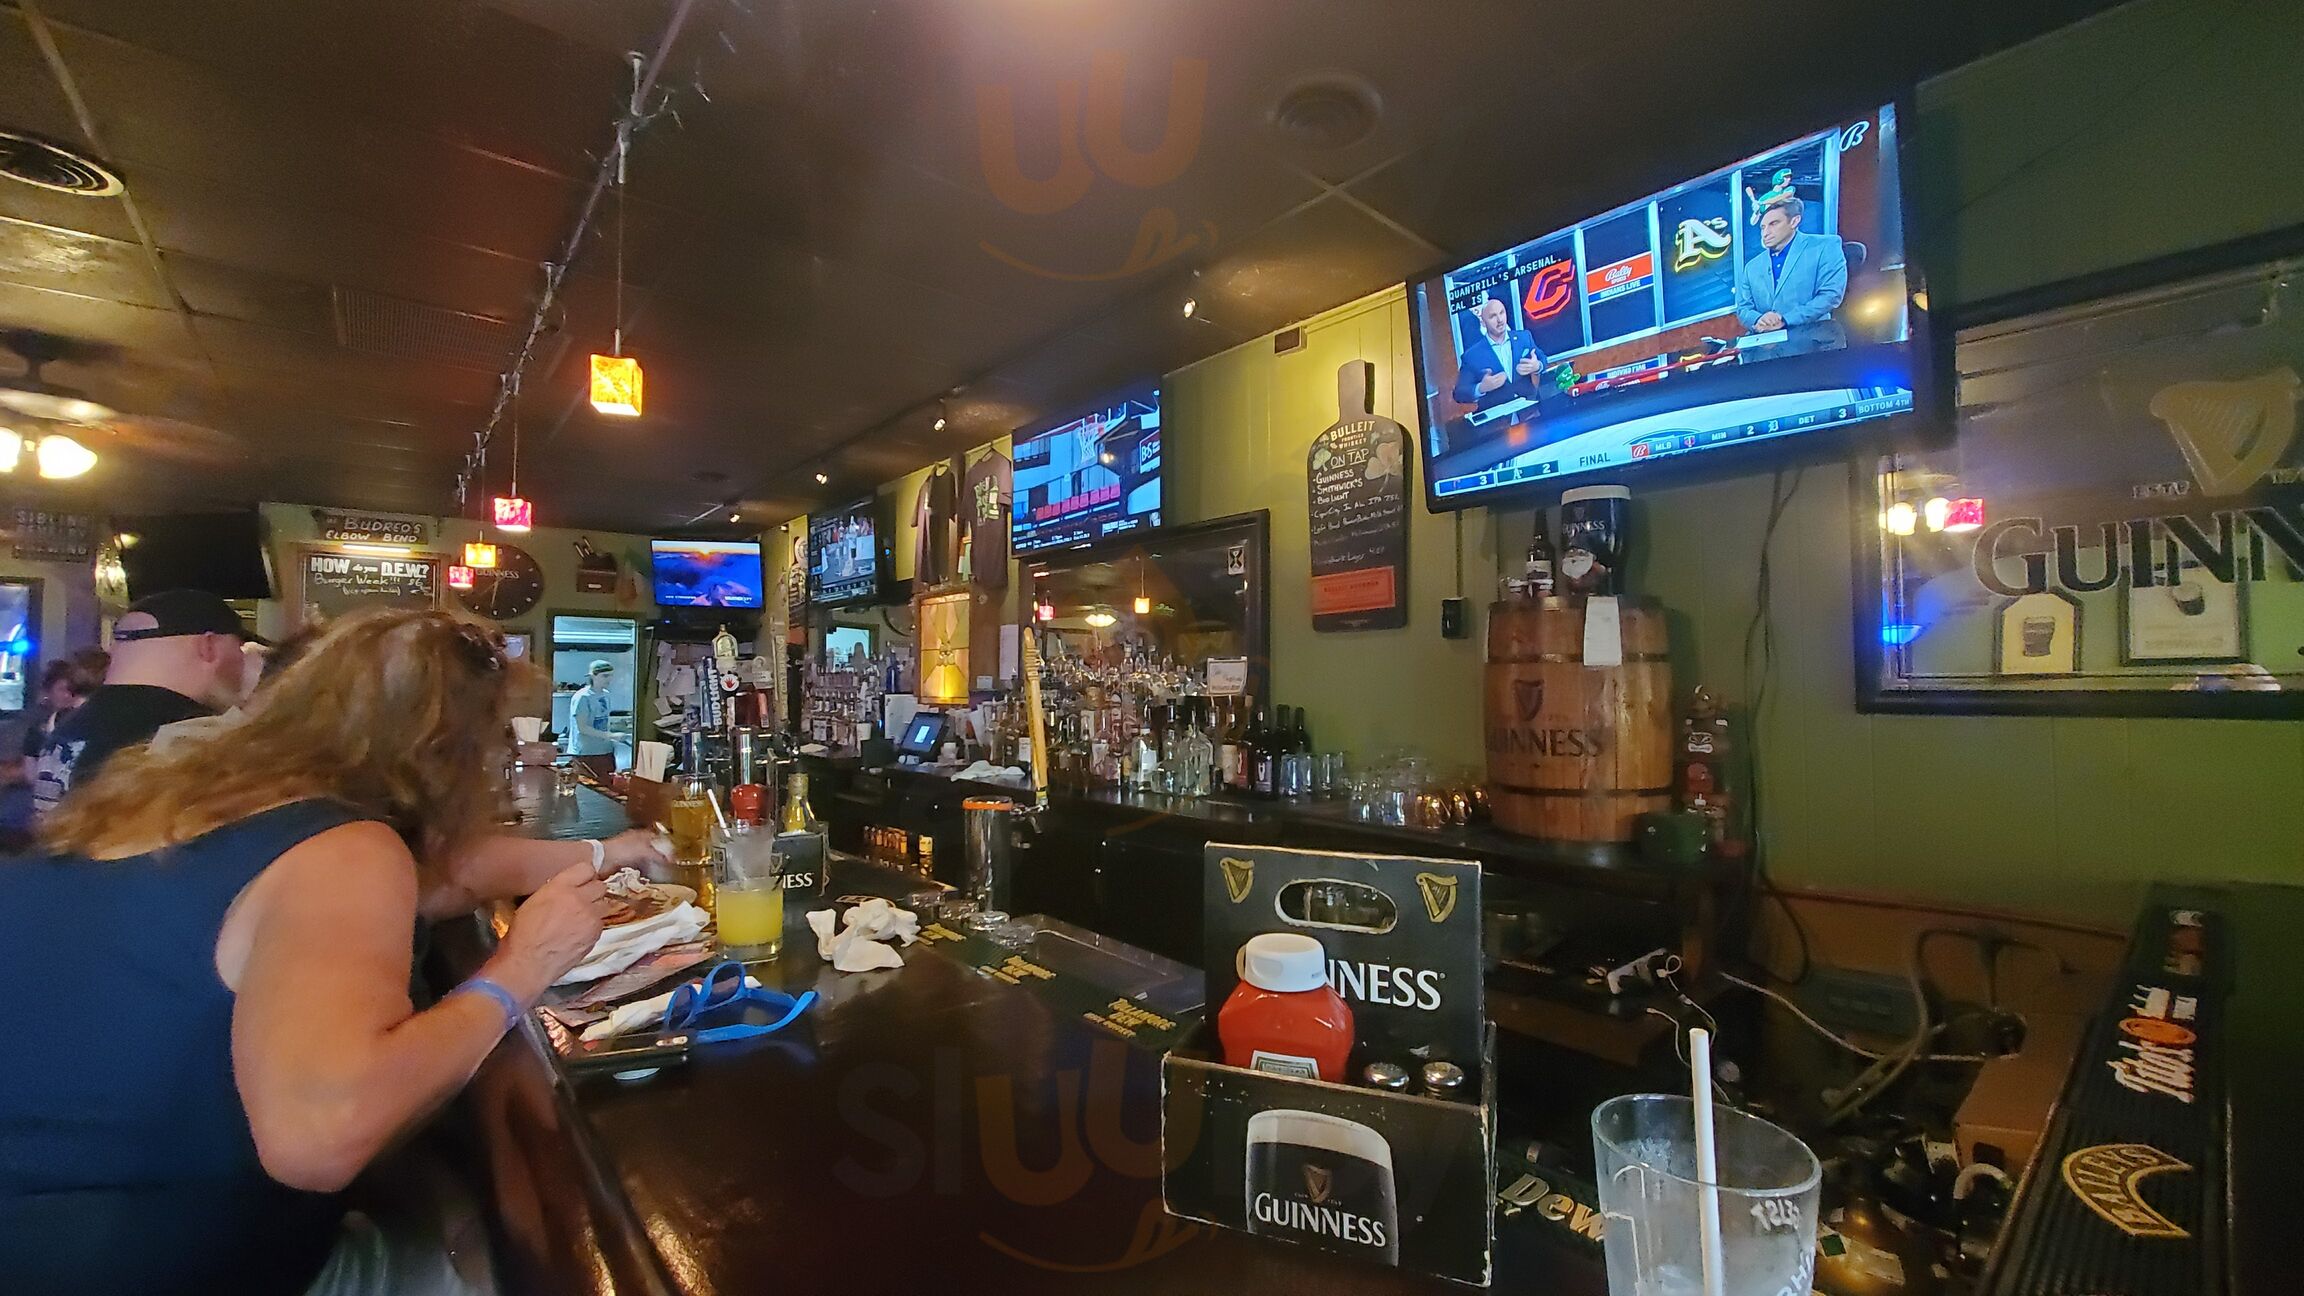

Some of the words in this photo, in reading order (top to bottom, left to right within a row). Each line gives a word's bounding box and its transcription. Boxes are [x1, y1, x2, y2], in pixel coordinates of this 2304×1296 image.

[1449, 272, 1509, 300] QUANTRILL'S
[1514, 255, 1561, 277] ARSENAL.
[1450, 301, 1466, 312] CAL
[1472, 295, 1482, 306] IS
[1746, 425, 1754, 436] 2
[1798, 415, 1815, 425] DET
[1838, 408, 1847, 418] 3
[1859, 401, 1893, 414] BOTTOM
[1330, 421, 1375, 442] BULLEIT
[1330, 454, 1345, 469] ON
[1347, 448, 1370, 465] TAP
[1479, 476, 1488, 485] 3
[1542, 464, 1551, 473] 2
[1579, 453, 1610, 467] FINAL
[1316, 469, 1354, 484] GUINNESS
[325, 530, 371, 541] ELBOW
[382, 533, 418, 543] BEND
[311, 557, 351, 574] HOW
[711, 701, 723, 726] BUD
[1255, 1192, 1386, 1248] GUINNESS
